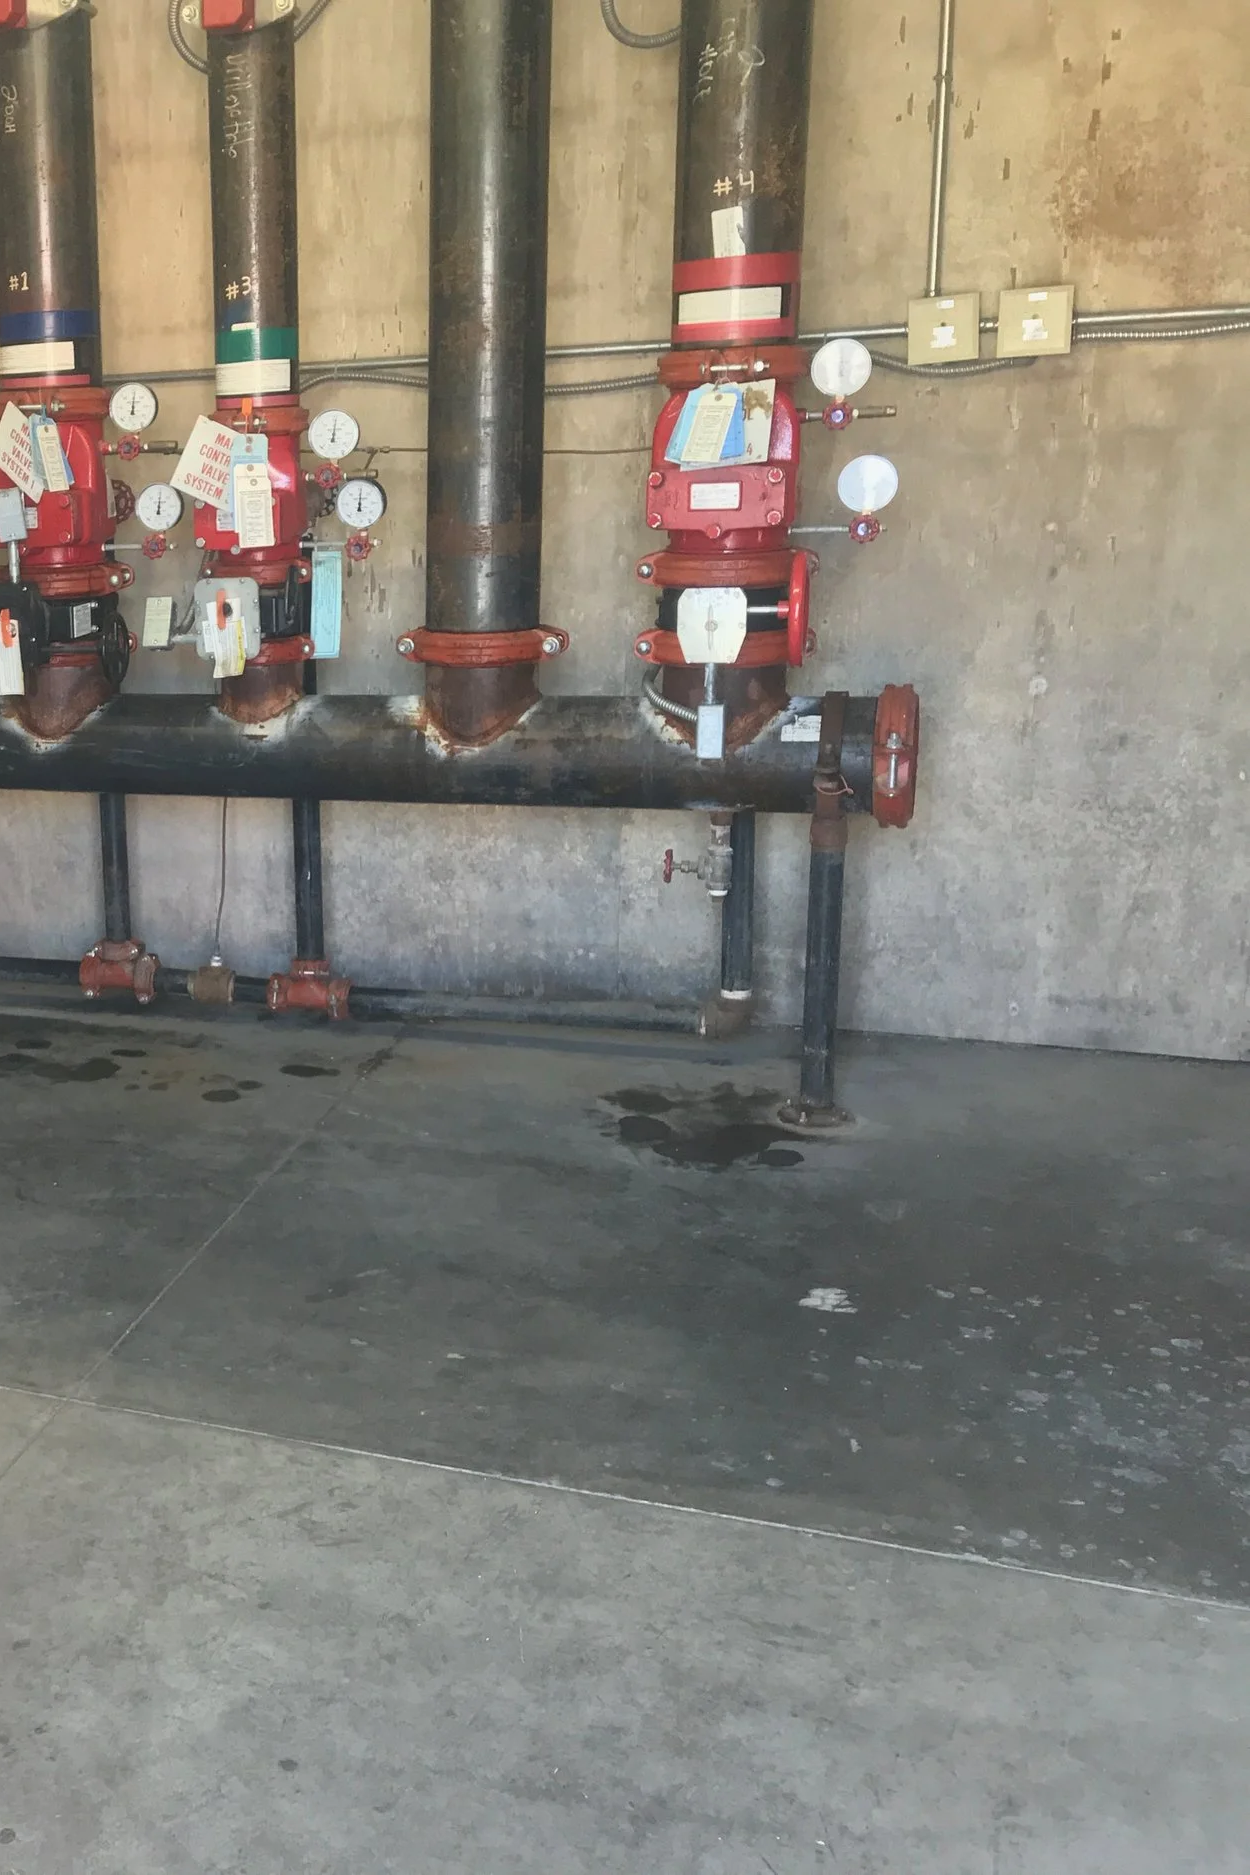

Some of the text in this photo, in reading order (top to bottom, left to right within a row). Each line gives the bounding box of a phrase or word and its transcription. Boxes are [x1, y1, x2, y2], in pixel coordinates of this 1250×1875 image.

[712, 168, 755, 197] #4
[8, 271, 30, 291] #1
[225, 275, 252, 300] #3
[0, 451, 30, 485] SYSTEM
[201, 462, 230, 486] VALVE
[183, 472, 224, 500] SYSTEM
